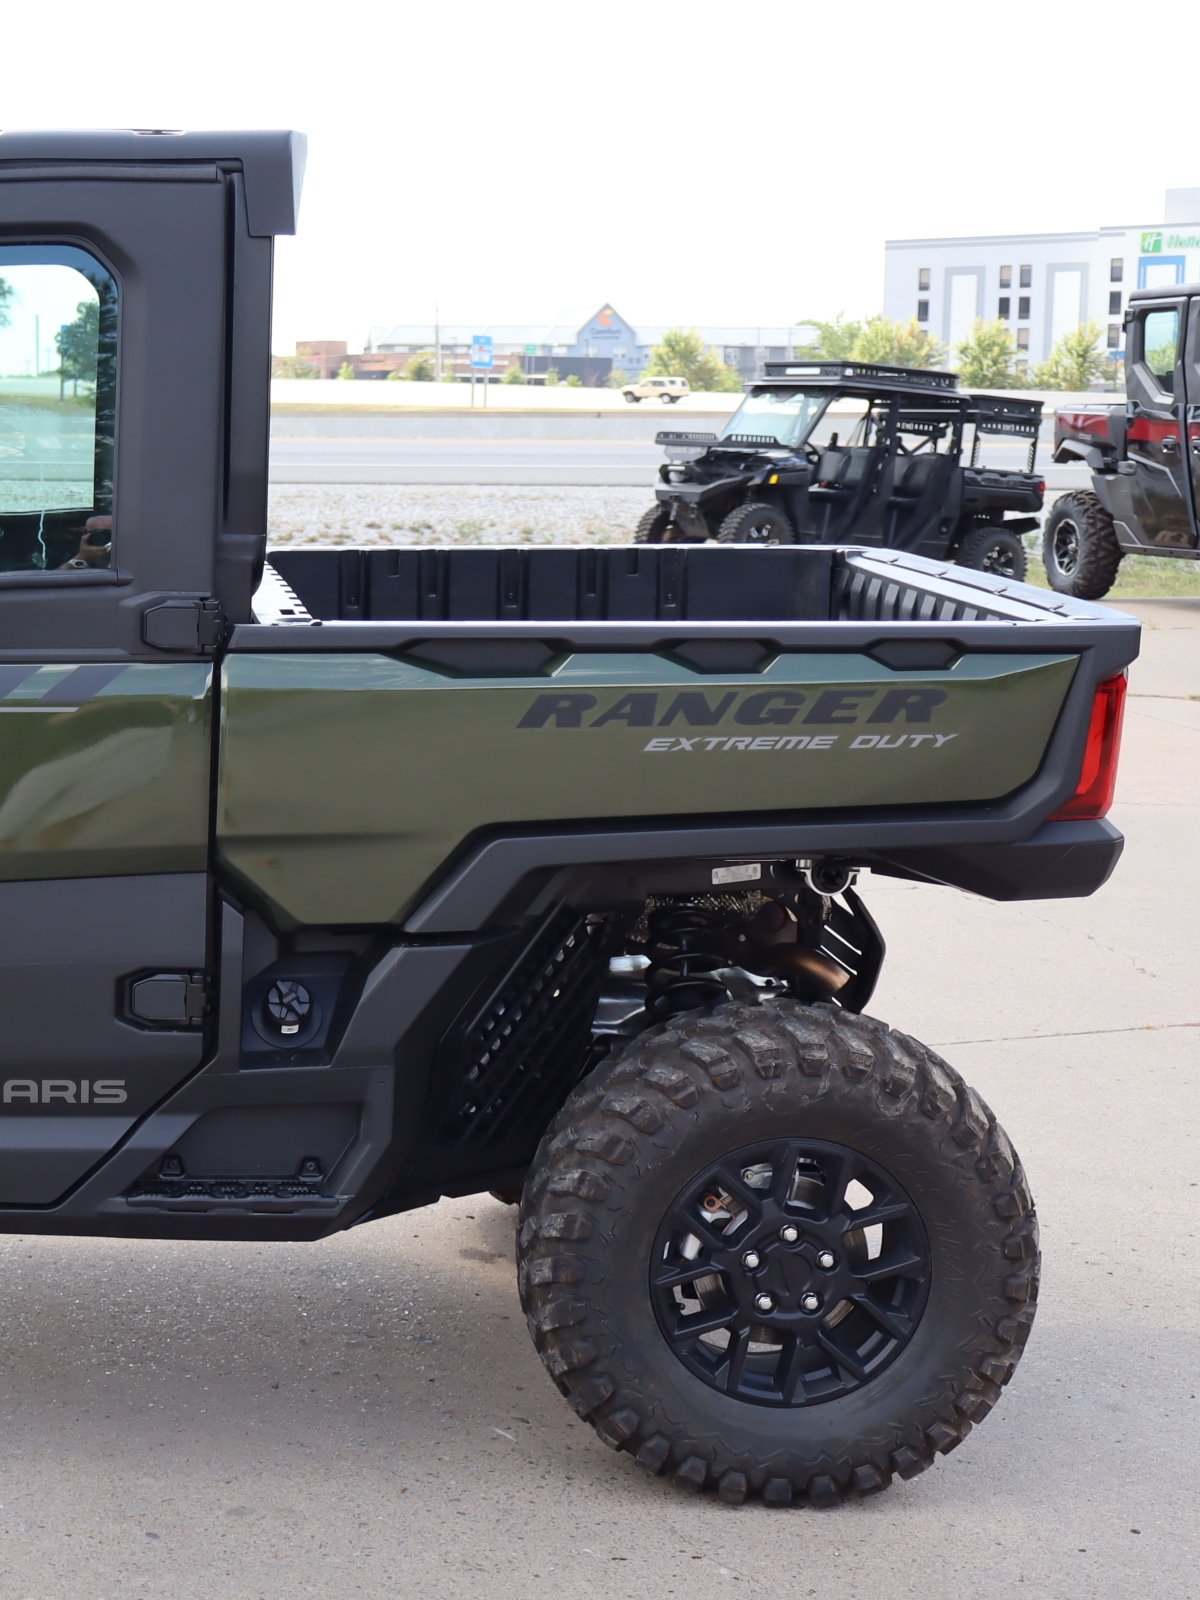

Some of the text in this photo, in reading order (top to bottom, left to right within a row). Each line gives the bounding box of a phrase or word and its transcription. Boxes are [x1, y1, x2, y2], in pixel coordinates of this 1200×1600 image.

[515, 688, 949, 729] RANGER
[642, 732, 960, 752] EXTREME DUTY
